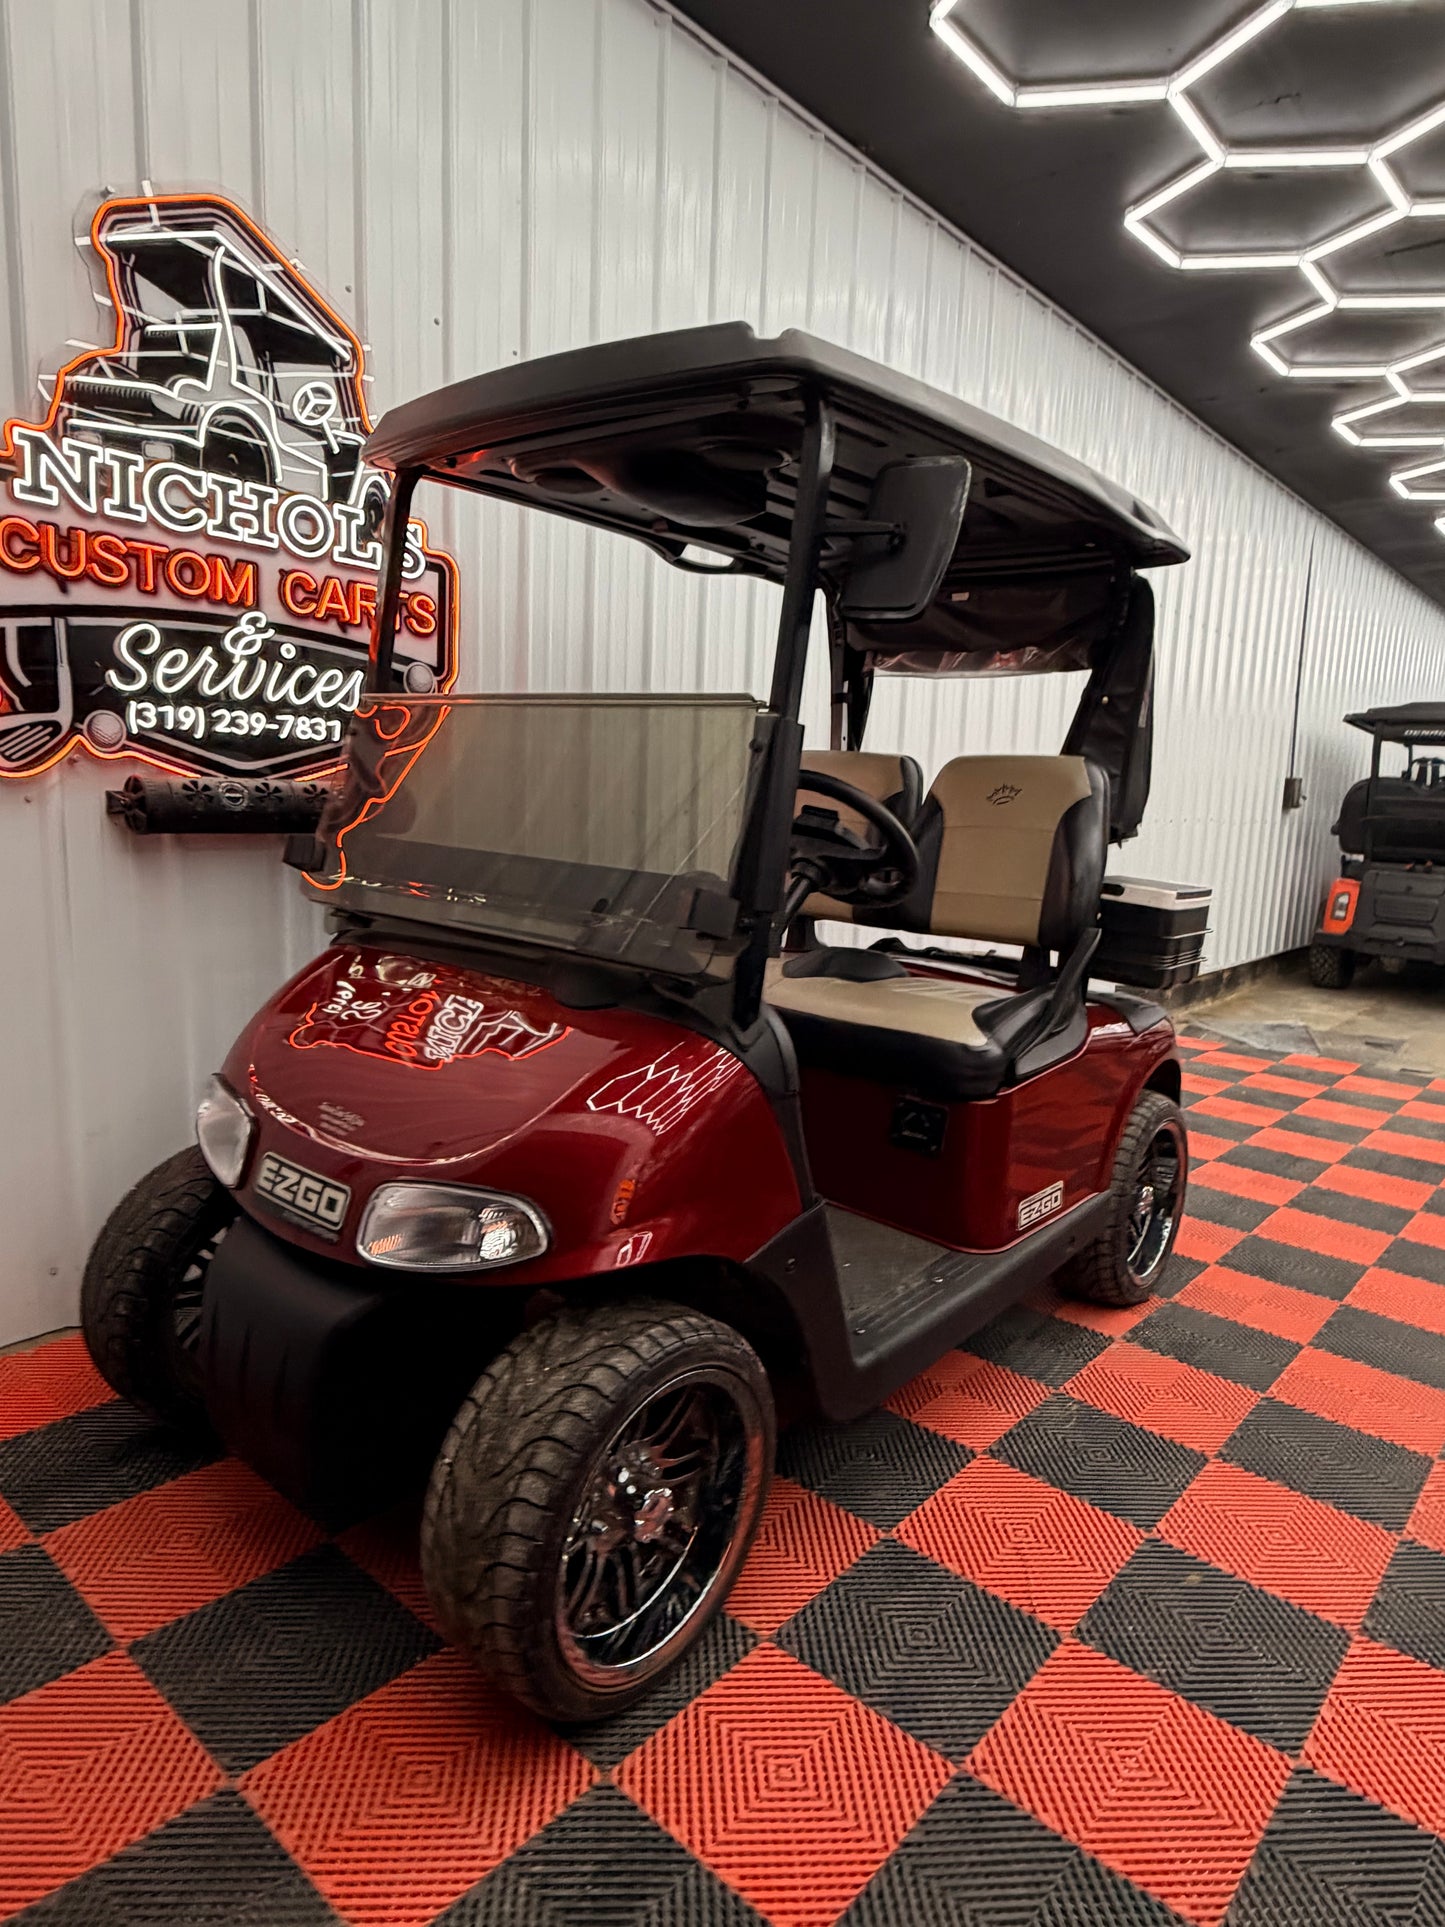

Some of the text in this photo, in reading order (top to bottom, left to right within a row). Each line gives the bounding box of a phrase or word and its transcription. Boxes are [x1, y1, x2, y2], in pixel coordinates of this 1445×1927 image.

[12, 428, 427, 580] NICHOLS
[0, 516, 256, 608] CUSTOM
[105, 622, 366, 713] Services
[223, 611, 276, 664] &
[126, 700, 343, 742] (319) 239-7831
